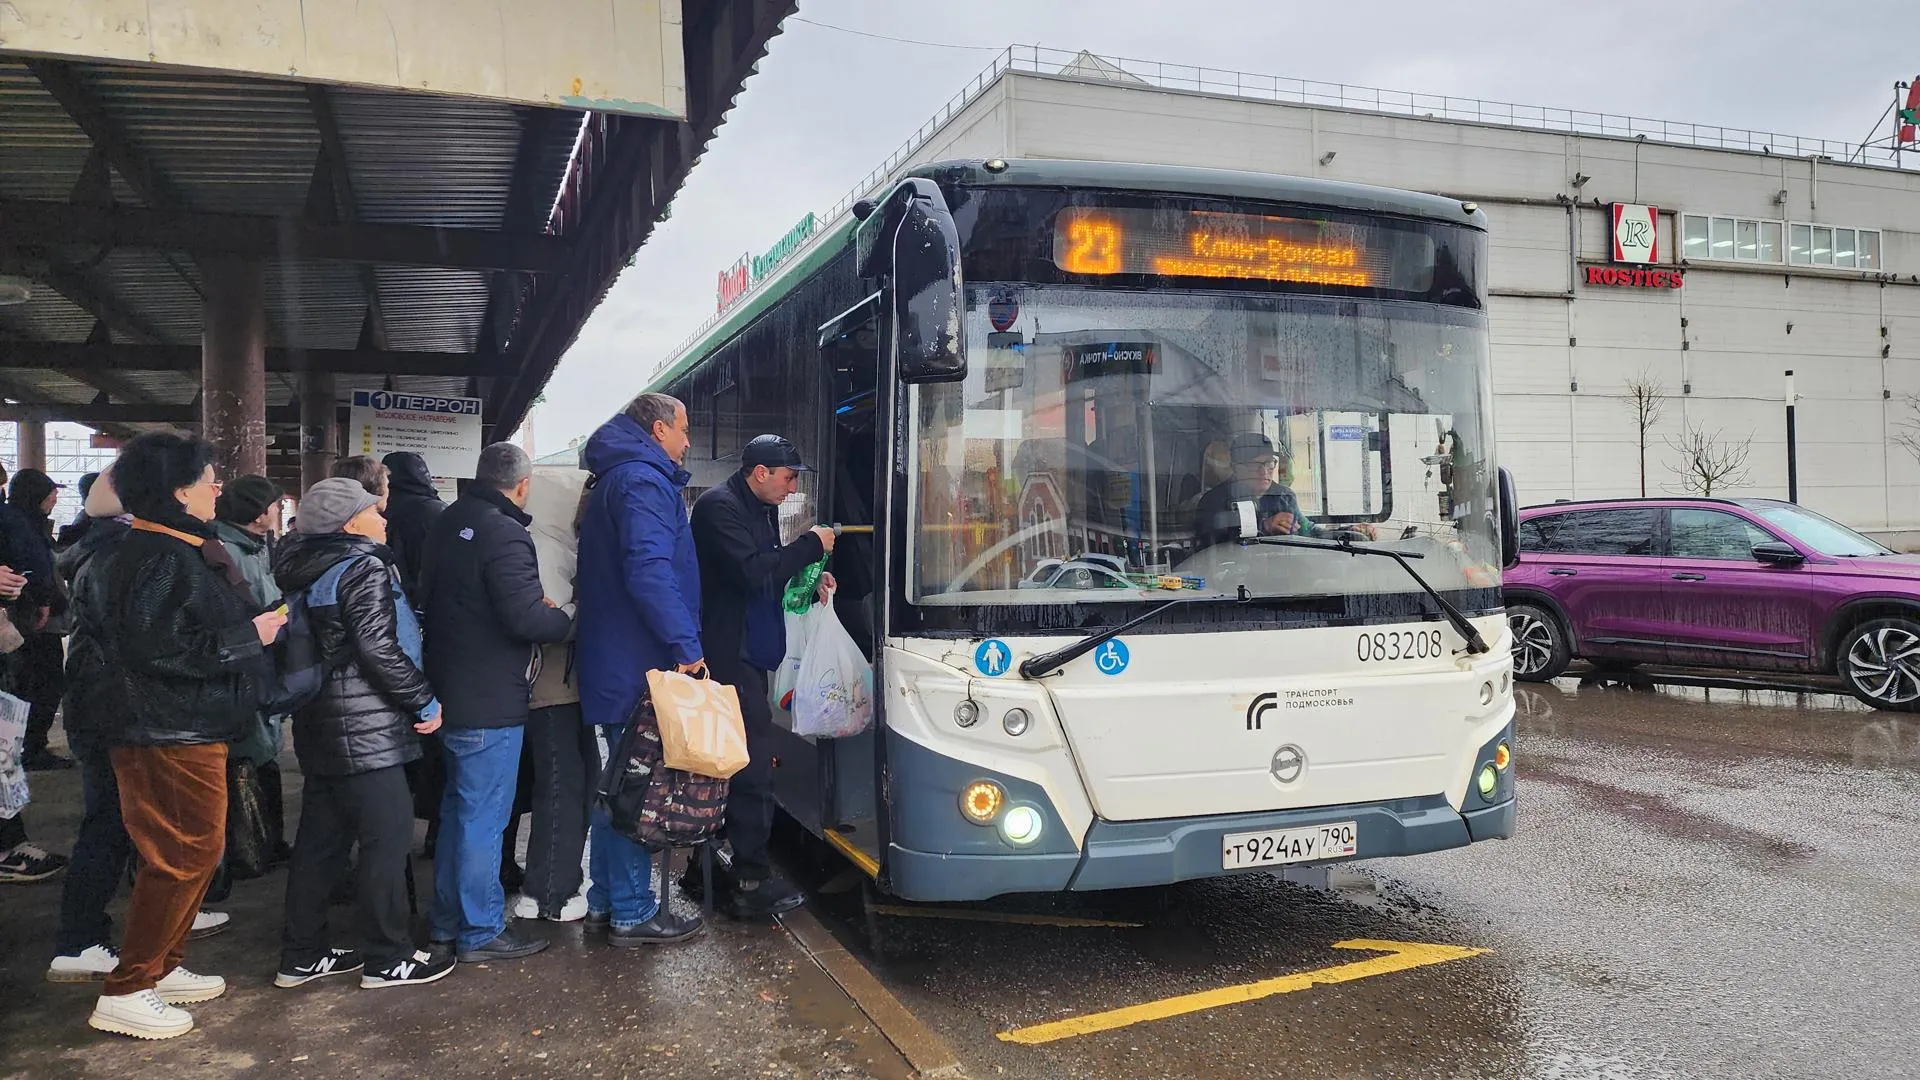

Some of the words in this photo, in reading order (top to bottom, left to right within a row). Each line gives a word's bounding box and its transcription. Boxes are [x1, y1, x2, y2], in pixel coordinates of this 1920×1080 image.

[1072, 223, 1114, 273] 23
[1587, 266, 1683, 289] ROSTIC'S
[375, 393, 386, 409] 1
[396, 396, 477, 414] ПЕРРОН
[1357, 630, 1442, 662] 083208
[1285, 688, 1338, 698] ТРАНСПОРТ
[1285, 698, 1354, 709] ПОДМОСКОВЬЯ
[1321, 826, 1350, 847] 790
[1233, 834, 1315, 864] Т924АУ
[1328, 846, 1343, 854] RUS
